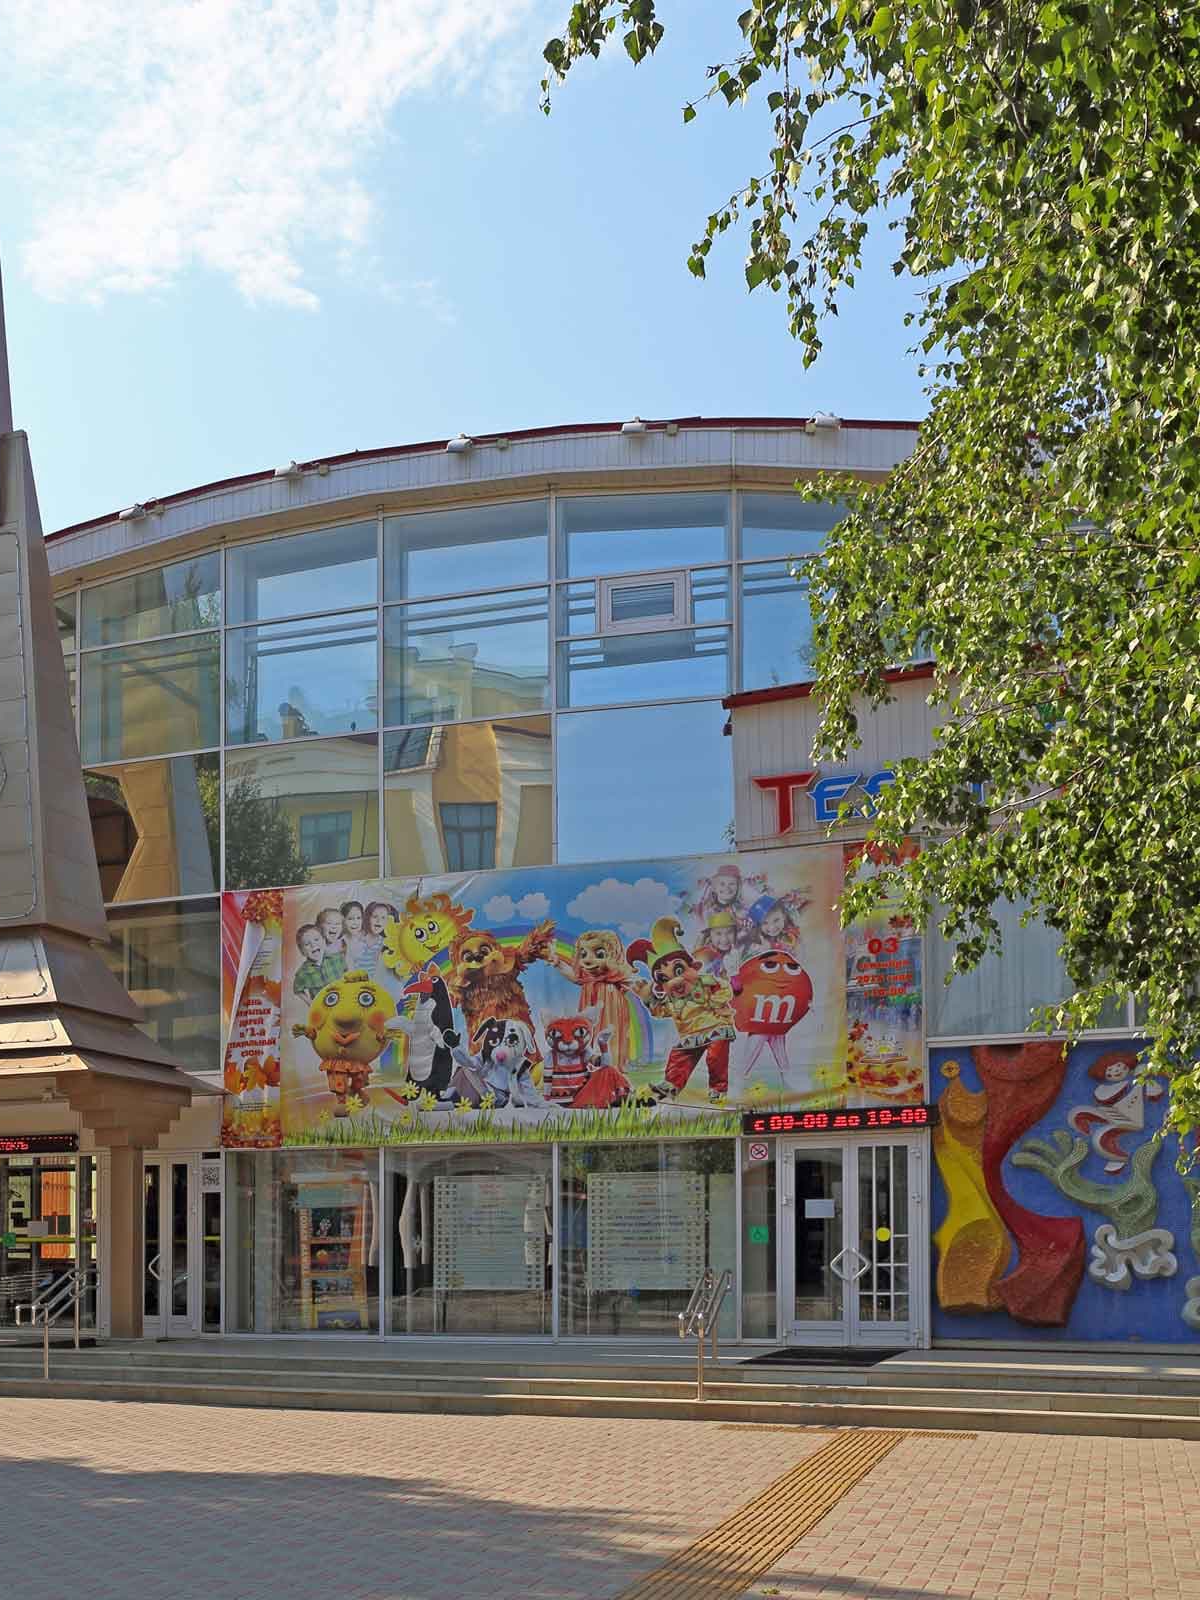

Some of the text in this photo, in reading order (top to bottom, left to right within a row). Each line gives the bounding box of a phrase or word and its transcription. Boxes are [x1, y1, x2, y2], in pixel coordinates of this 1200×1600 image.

[750, 992, 796, 1024] m
[771, 1113, 827, 1130] 09-00
[833, 1115, 860, 1128] до
[867, 1108, 927, 1126] 19-00
